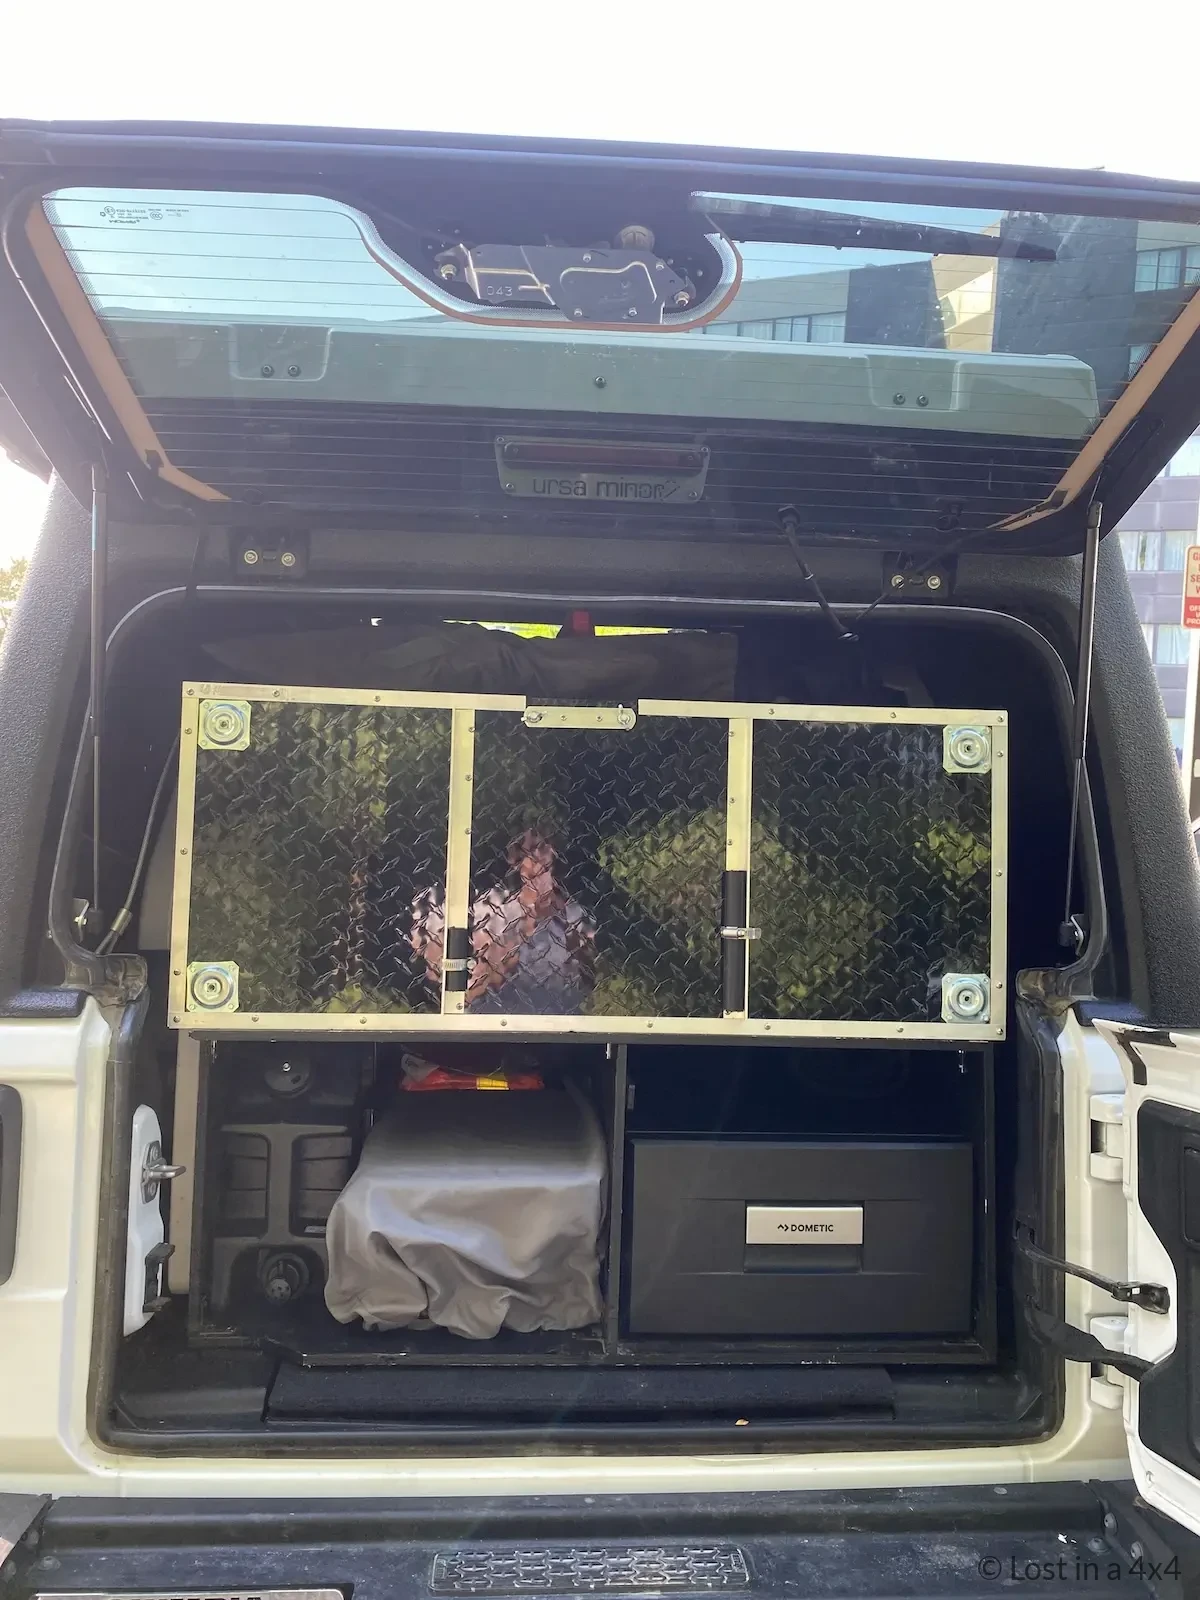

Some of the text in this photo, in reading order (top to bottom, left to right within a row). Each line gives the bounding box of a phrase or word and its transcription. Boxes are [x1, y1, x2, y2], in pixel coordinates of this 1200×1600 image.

[533, 477, 664, 499] ursa minor
[790, 1224, 834, 1232] DOMETIC
